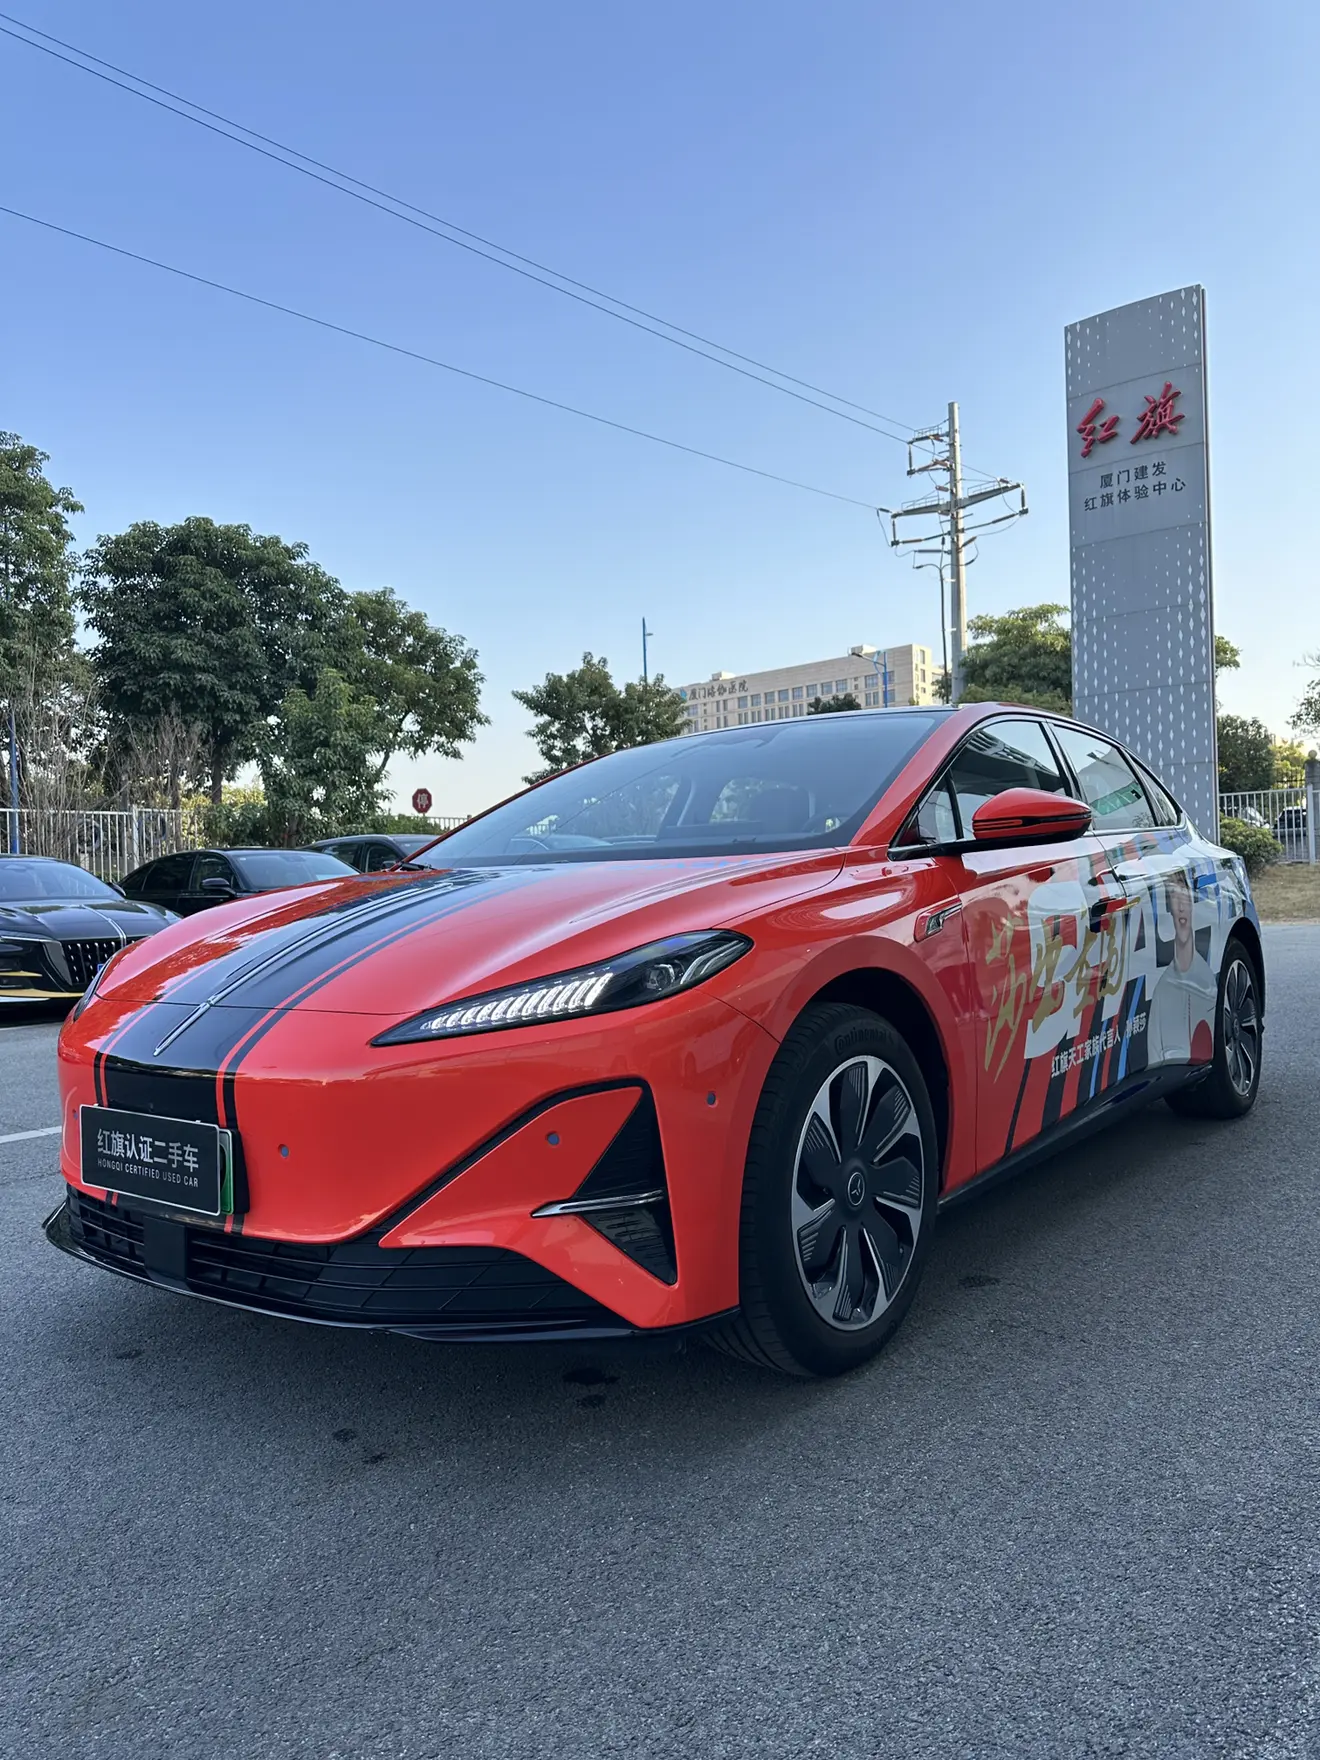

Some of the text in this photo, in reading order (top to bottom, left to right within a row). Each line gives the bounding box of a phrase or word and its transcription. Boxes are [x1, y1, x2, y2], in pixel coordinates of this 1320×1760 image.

[1076, 381, 1186, 459] 红旗
[1099, 461, 1168, 489] 厦门建发
[1084, 477, 1187, 512] 红旗体验中心
[416, 793, 430, 809] 停
[1051, 1024, 1121, 1078] 红旗天工家族代言人
[97, 1128, 199, 1173] 红旗认证二手车
[98, 1158, 199, 1188] HONGQI CERTIFIED USED CAR
